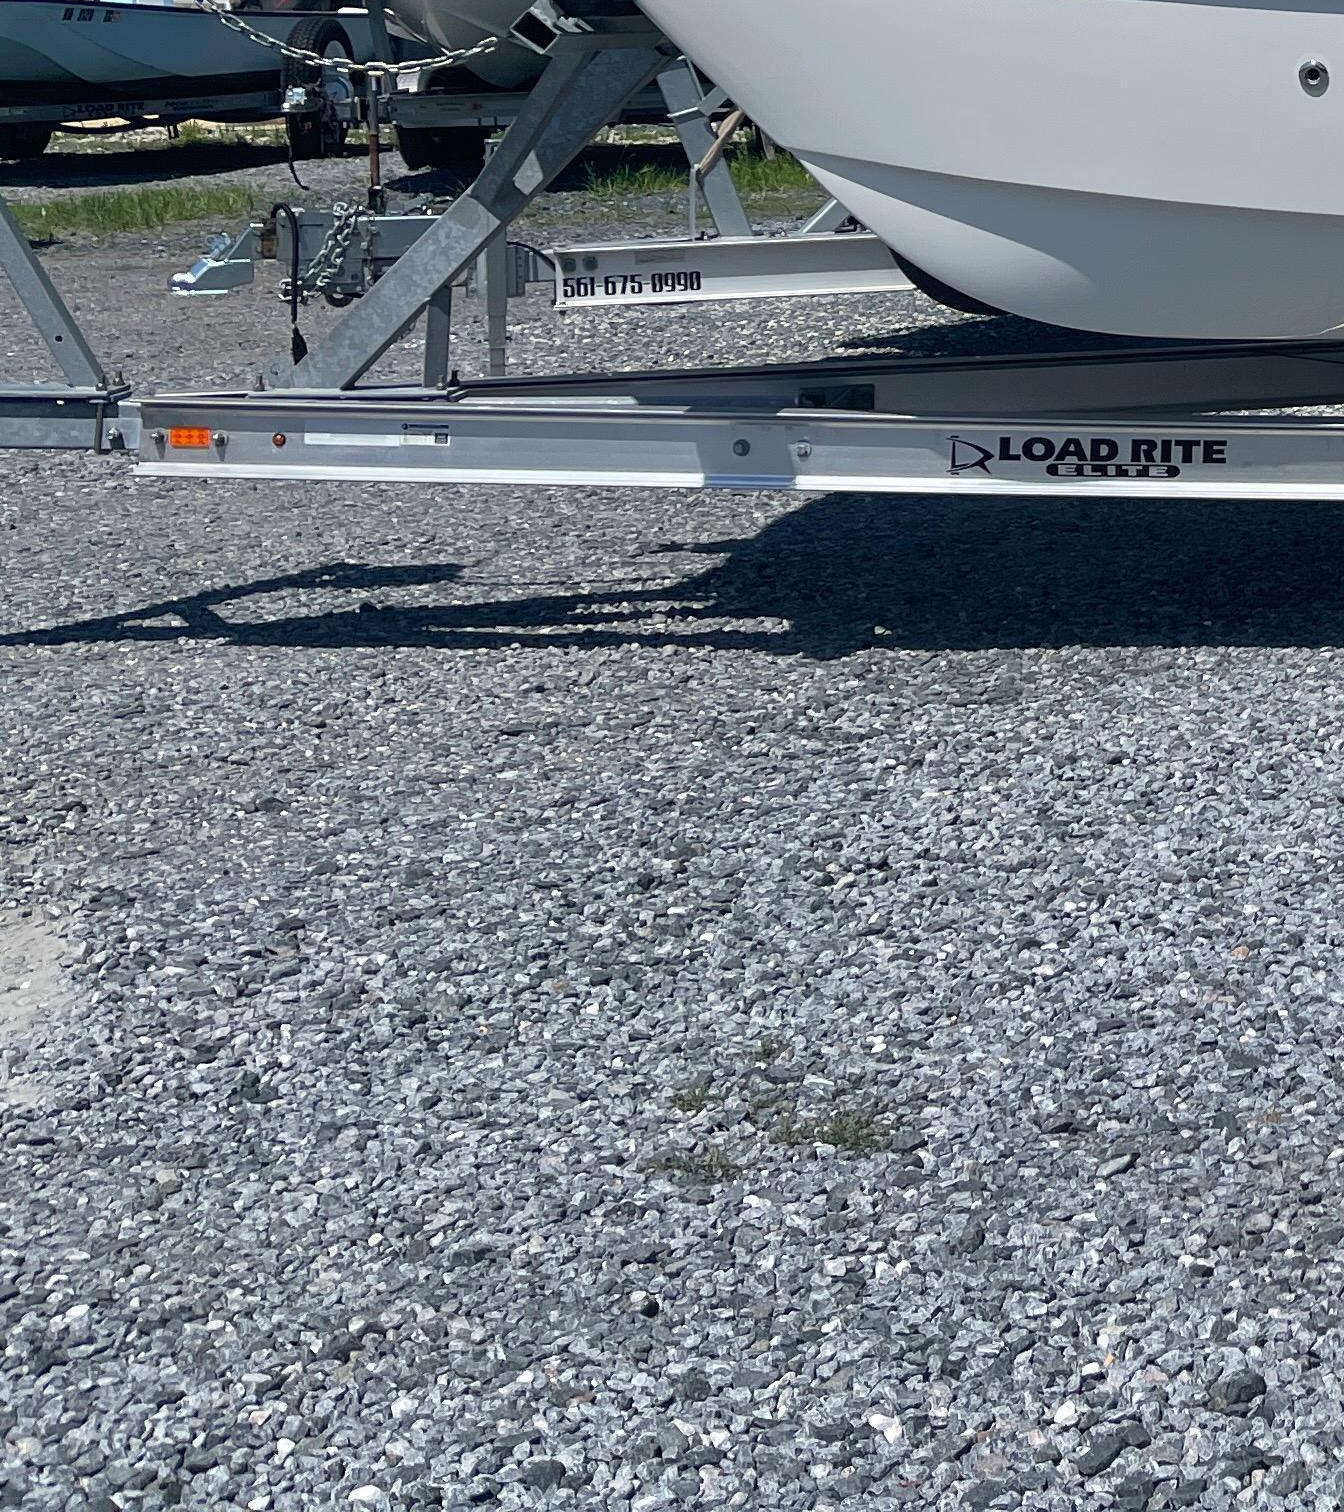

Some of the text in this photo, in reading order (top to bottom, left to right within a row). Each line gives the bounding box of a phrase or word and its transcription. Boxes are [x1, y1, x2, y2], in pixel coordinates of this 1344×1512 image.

[563, 271, 702, 298] 561-675-0990
[998, 437, 1227, 463] LOAD RITE
[1057, 464, 1169, 477] ELITE
